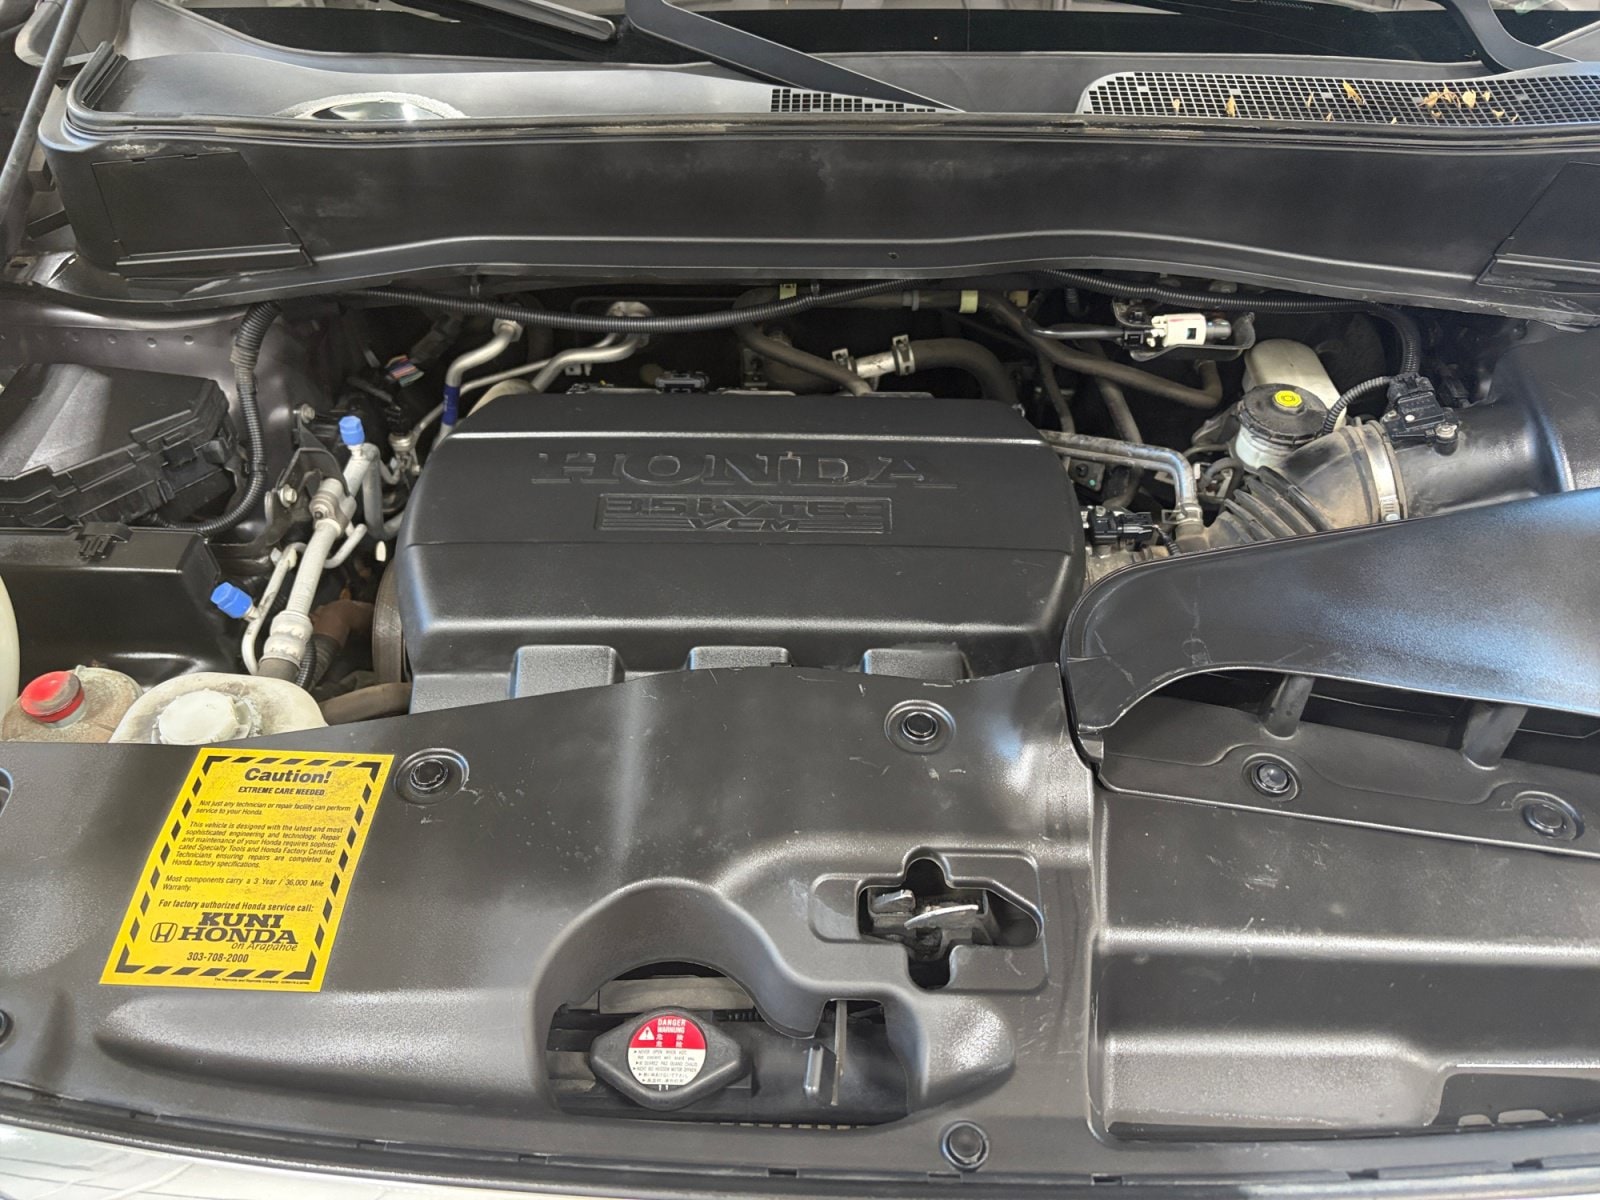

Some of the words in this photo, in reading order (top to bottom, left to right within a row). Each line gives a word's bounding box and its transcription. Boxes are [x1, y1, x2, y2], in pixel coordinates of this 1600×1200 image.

[531, 451, 958, 489] HONDA
[687, 517, 799, 533] VCM
[244, 767, 333, 784] Caution!
[238, 786, 273, 794] EXTREME
[274, 787, 295, 795] CARE
[295, 788, 325, 796] NEEDED
[294, 803, 314, 811] facility
[197, 844, 227, 852] Specialty
[283, 847, 307, 855] Factory
[176, 850, 212, 858] Technicians
[215, 853, 244, 861] ensuring
[193, 859, 216, 868] factory
[285, 879, 309, 887] 36,000
[158, 899, 172, 907] For
[172, 899, 199, 910] factory
[200, 901, 241, 910] authorized
[241, 902, 266, 911] Honda
[267, 903, 296, 911] service
[296, 904, 315, 912] call:
[198, 912, 285, 928] KUNI
[178, 926, 299, 944] HONDA
[246, 942, 298, 952] Arapahoe
[187, 952, 249, 963] 303-708-2000
[657, 1018, 687, 1027] DANGER
